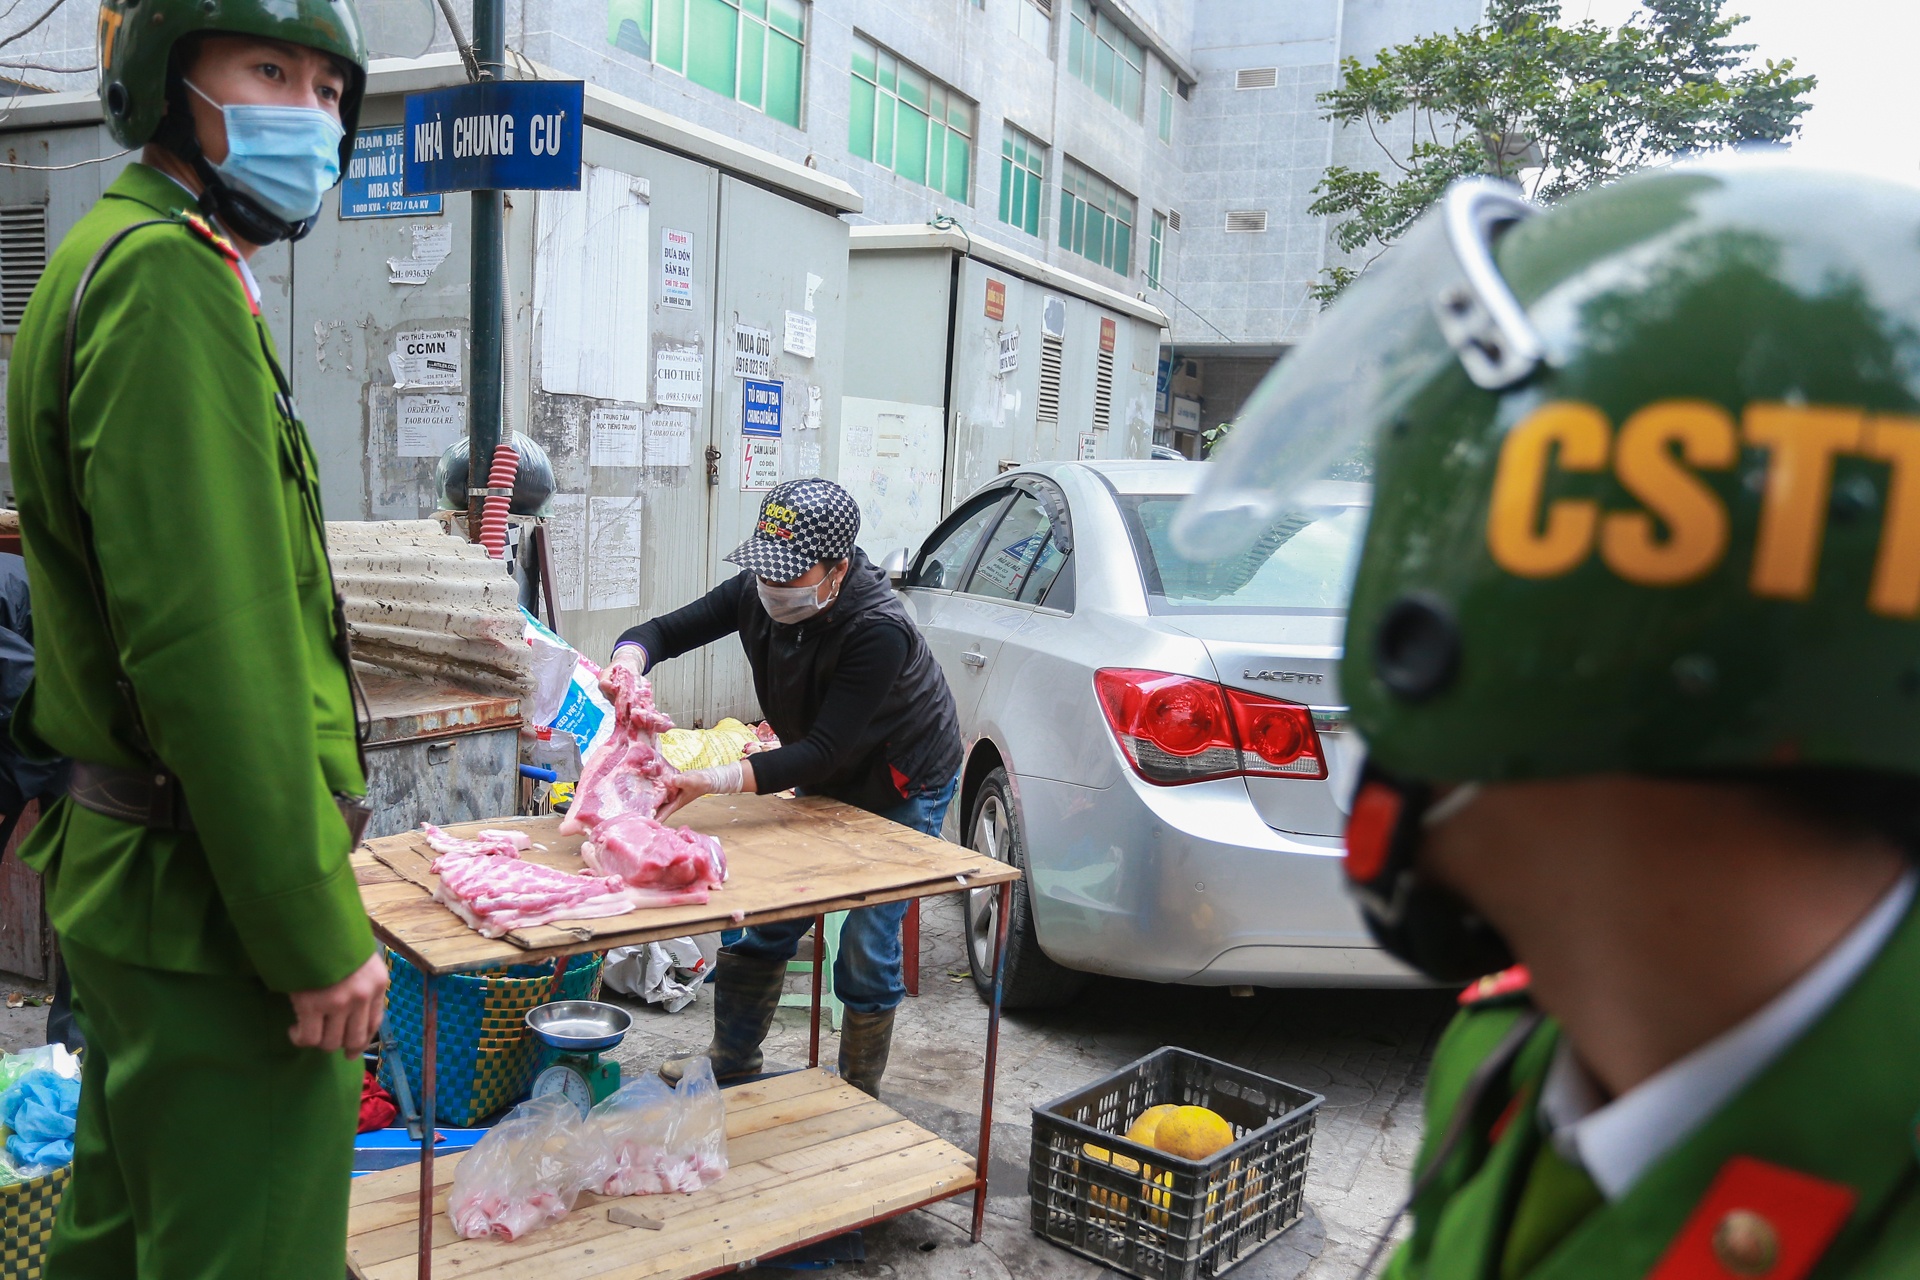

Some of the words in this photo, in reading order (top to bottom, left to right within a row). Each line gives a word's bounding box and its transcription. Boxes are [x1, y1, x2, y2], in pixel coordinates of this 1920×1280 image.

[354, 135, 382, 152] TRẠM
[414, 112, 443, 163] NHÀ
[453, 114, 514, 158] CHUNG
[530, 110, 565, 156] CƯ
[349, 158, 366, 179] KHU
[369, 151, 387, 177] NHÀ
[389, 147, 397, 175] Ở
[368, 182, 390, 198] MBA
[352, 204, 368, 213] 1000
[368, 203, 380, 212] KVA
[420, 200, 429, 209] KV
[664, 248, 677, 260] ĐƯA
[678, 249, 690, 261] ĐÓN
[678, 266, 690, 277] BAY
[407, 342, 446, 355] CCMN
[737, 332, 754, 354] MUA
[756, 332, 770, 357] ÔTÔ
[736, 356, 748, 373] 0916
[759, 361, 768, 376] 519
[658, 368, 677, 380] CHO
[678, 368, 702, 381] THUÊ
[768, 391, 779, 406] TBA
[765, 503, 798, 524] GUCCI
[1486, 397, 1920, 619] CSTT
[566, 703, 579, 716] VIỆT
